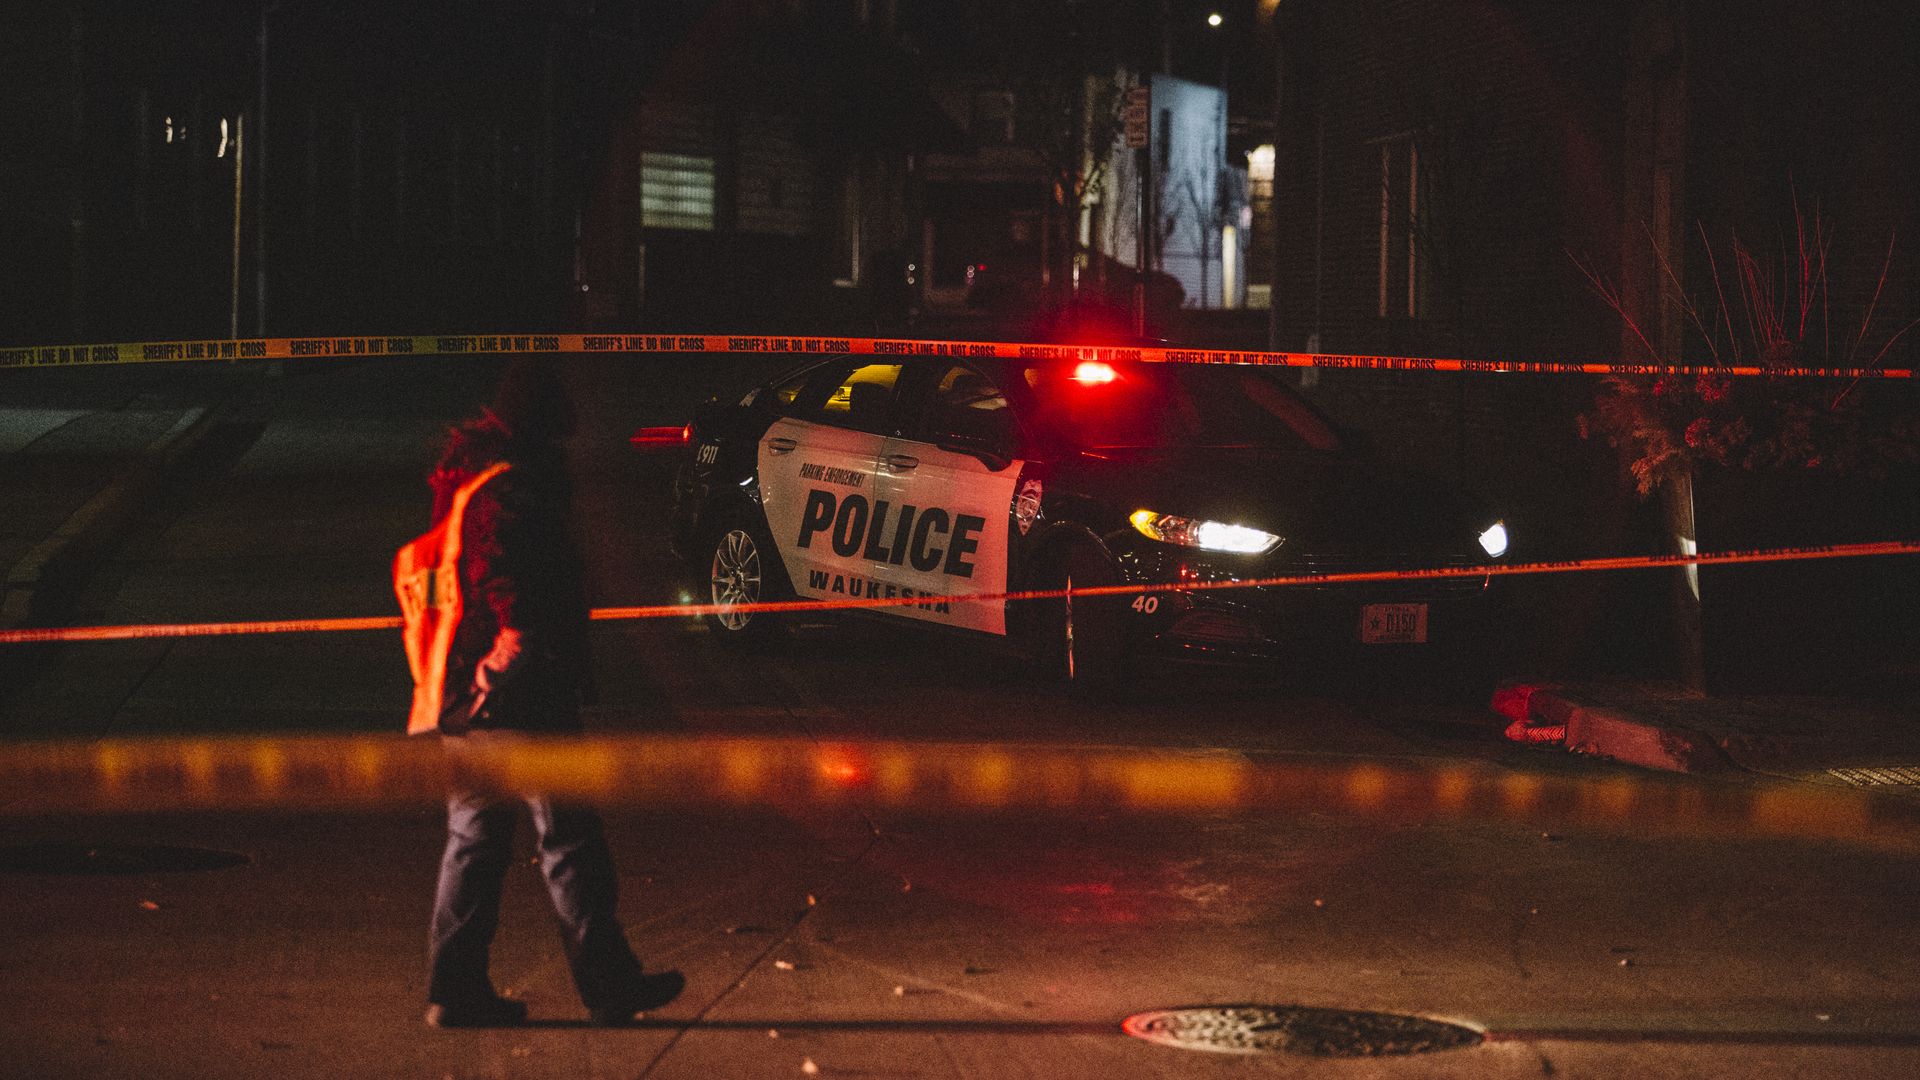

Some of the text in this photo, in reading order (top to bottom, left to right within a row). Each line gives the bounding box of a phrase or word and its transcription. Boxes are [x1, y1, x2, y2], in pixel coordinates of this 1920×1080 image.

[143, 342, 266, 360] SHERIFF'S LINE DO NOT CROSS
[290, 338, 413, 355] SHERIFF'S LINE DO NOT CROSS
[437, 336, 559, 351] SHERIFF'S LINE DO NOT CROSS
[583, 336, 705, 350] SHERIFF'S LINE DO NOT CROSS
[728, 338, 850, 352] SHERIFF'S LINE DO NOT CROSS
[874, 341, 996, 357] SHERIFF'S LINE DO NOT CROSS
[1019, 346, 1142, 361] SHERIFF'S LINE DO NOT CROSS
[1165, 351, 1288, 365] SHERIFF'S LINE DO NOT CROSS
[1312, 356, 1436, 370] SHERIFF'S LINE DO NOT CROSS
[799, 462, 867, 488] PARKING ENFORCEMENT
[797, 489, 986, 578] POLICE
[809, 570, 950, 614] WAUKESHA
[1131, 595, 1159, 614] 40
